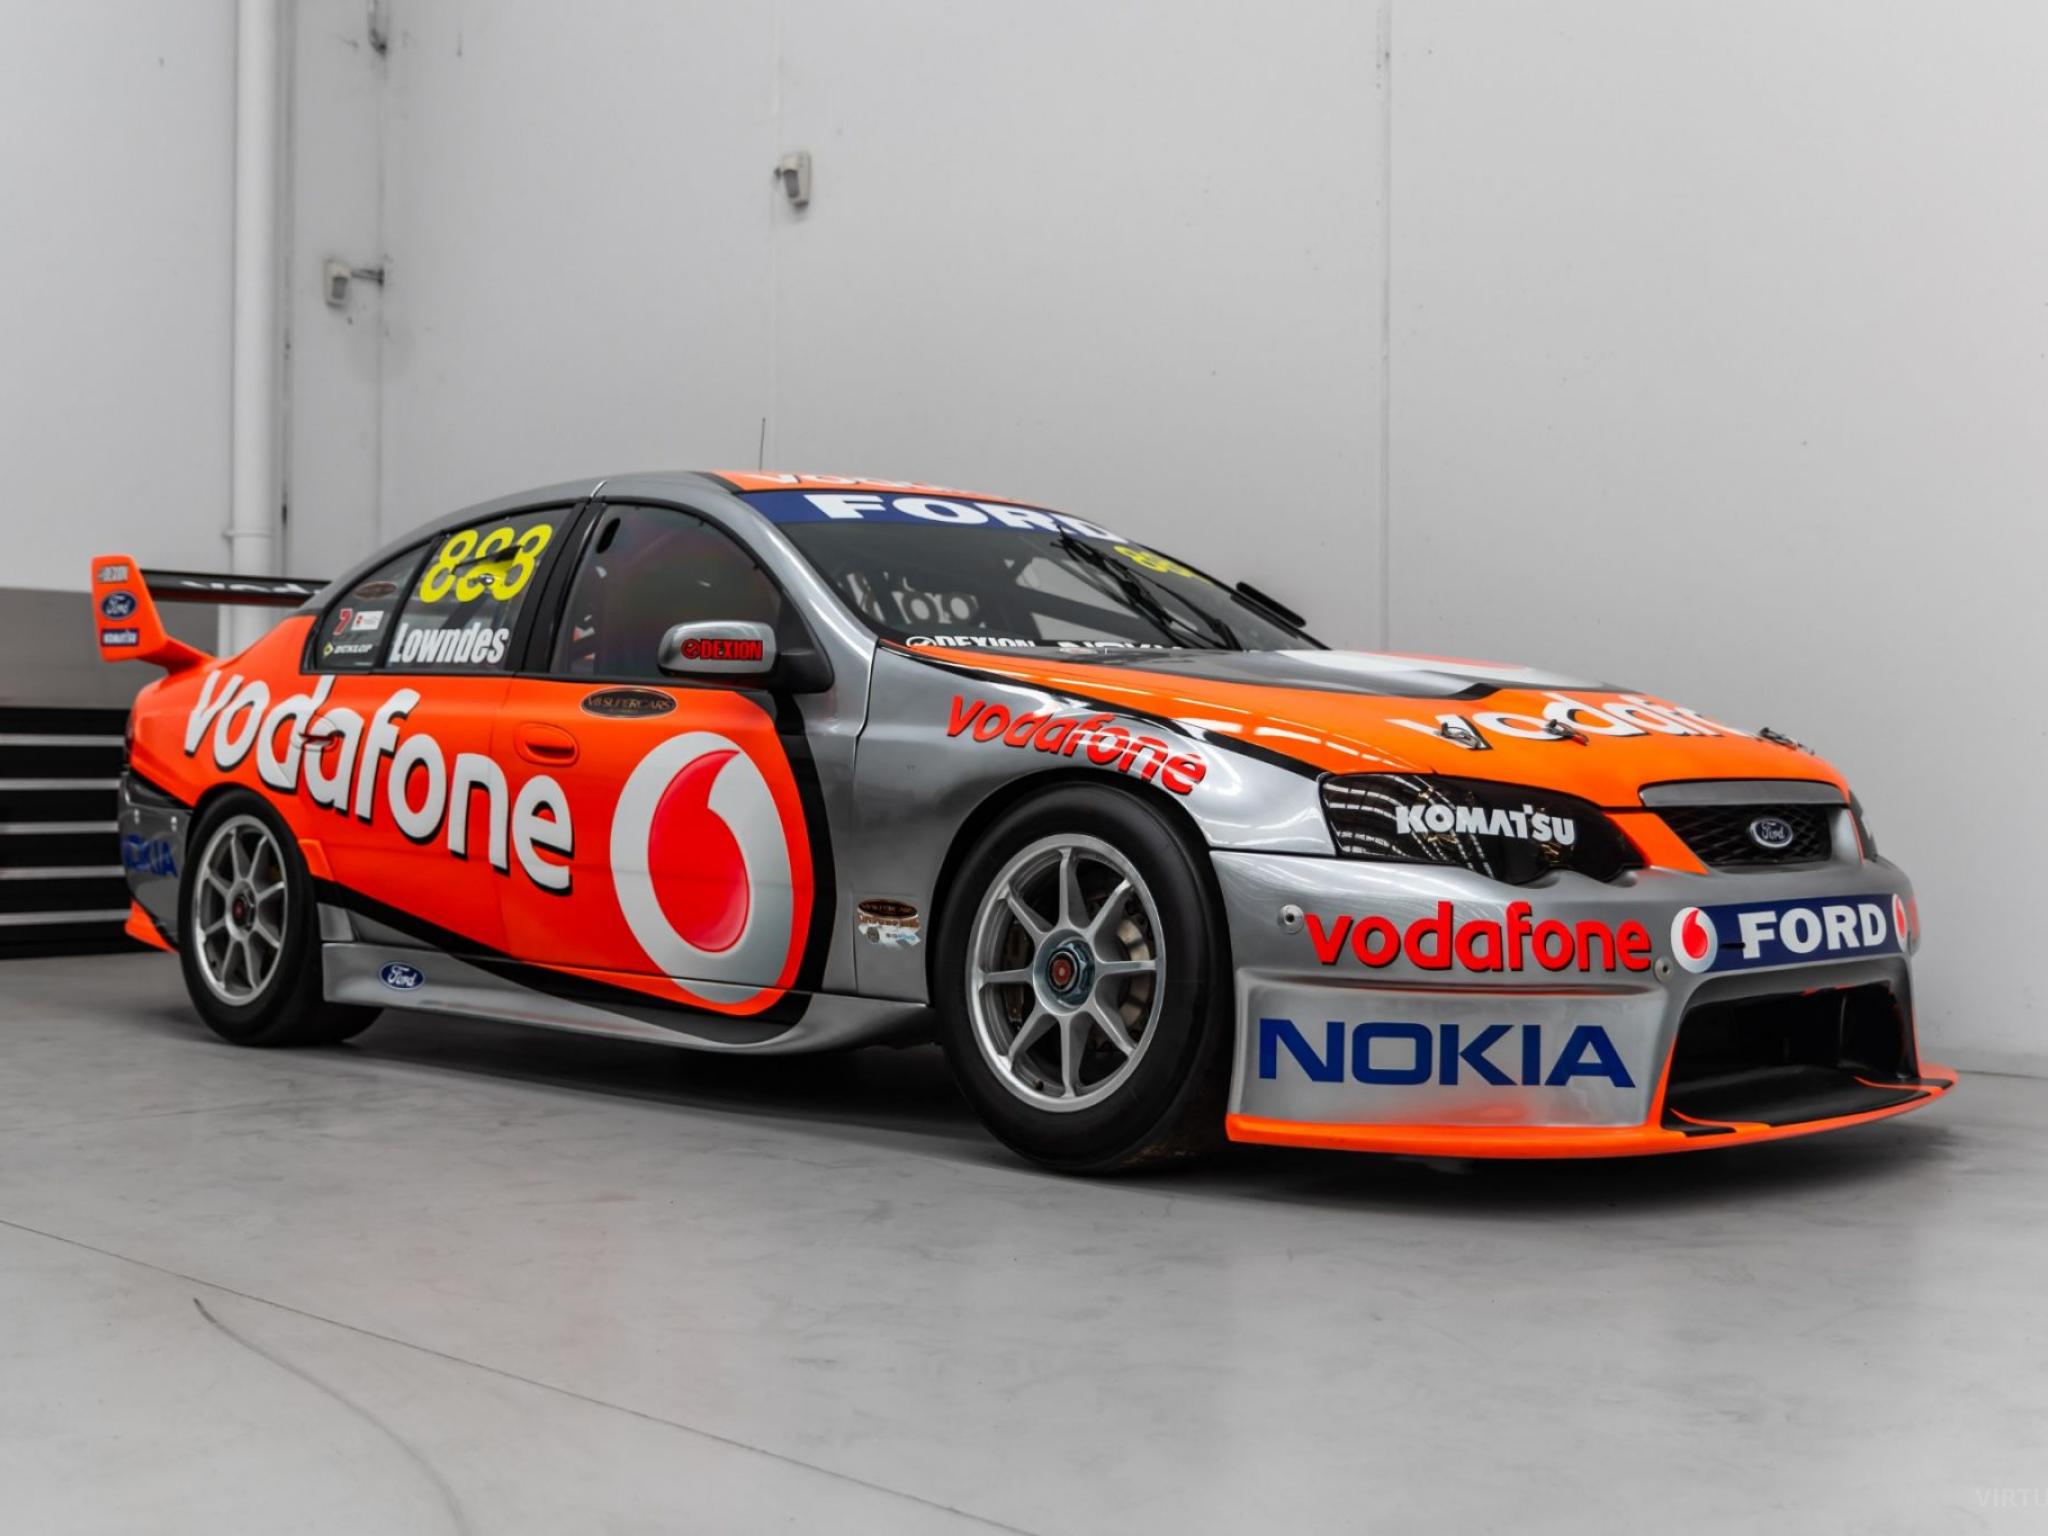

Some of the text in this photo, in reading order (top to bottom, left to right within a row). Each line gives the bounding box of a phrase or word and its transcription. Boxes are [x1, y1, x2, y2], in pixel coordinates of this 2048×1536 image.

[803, 493, 1131, 544] FORD
[419, 524, 553, 603] 888
[389, 622, 511, 664] Lowndes
[700, 639, 763, 660] DEXION
[946, 694, 1207, 795] vodafone
[184, 669, 574, 896] vodafone
[1395, 803, 1575, 845] KOMATSU
[1760, 820, 1787, 841] Ford
[1304, 901, 1652, 973] vodafone
[1738, 903, 1887, 960] FORD
[387, 965, 417, 987] Ford
[1258, 1018, 1636, 1088] NOKIA
